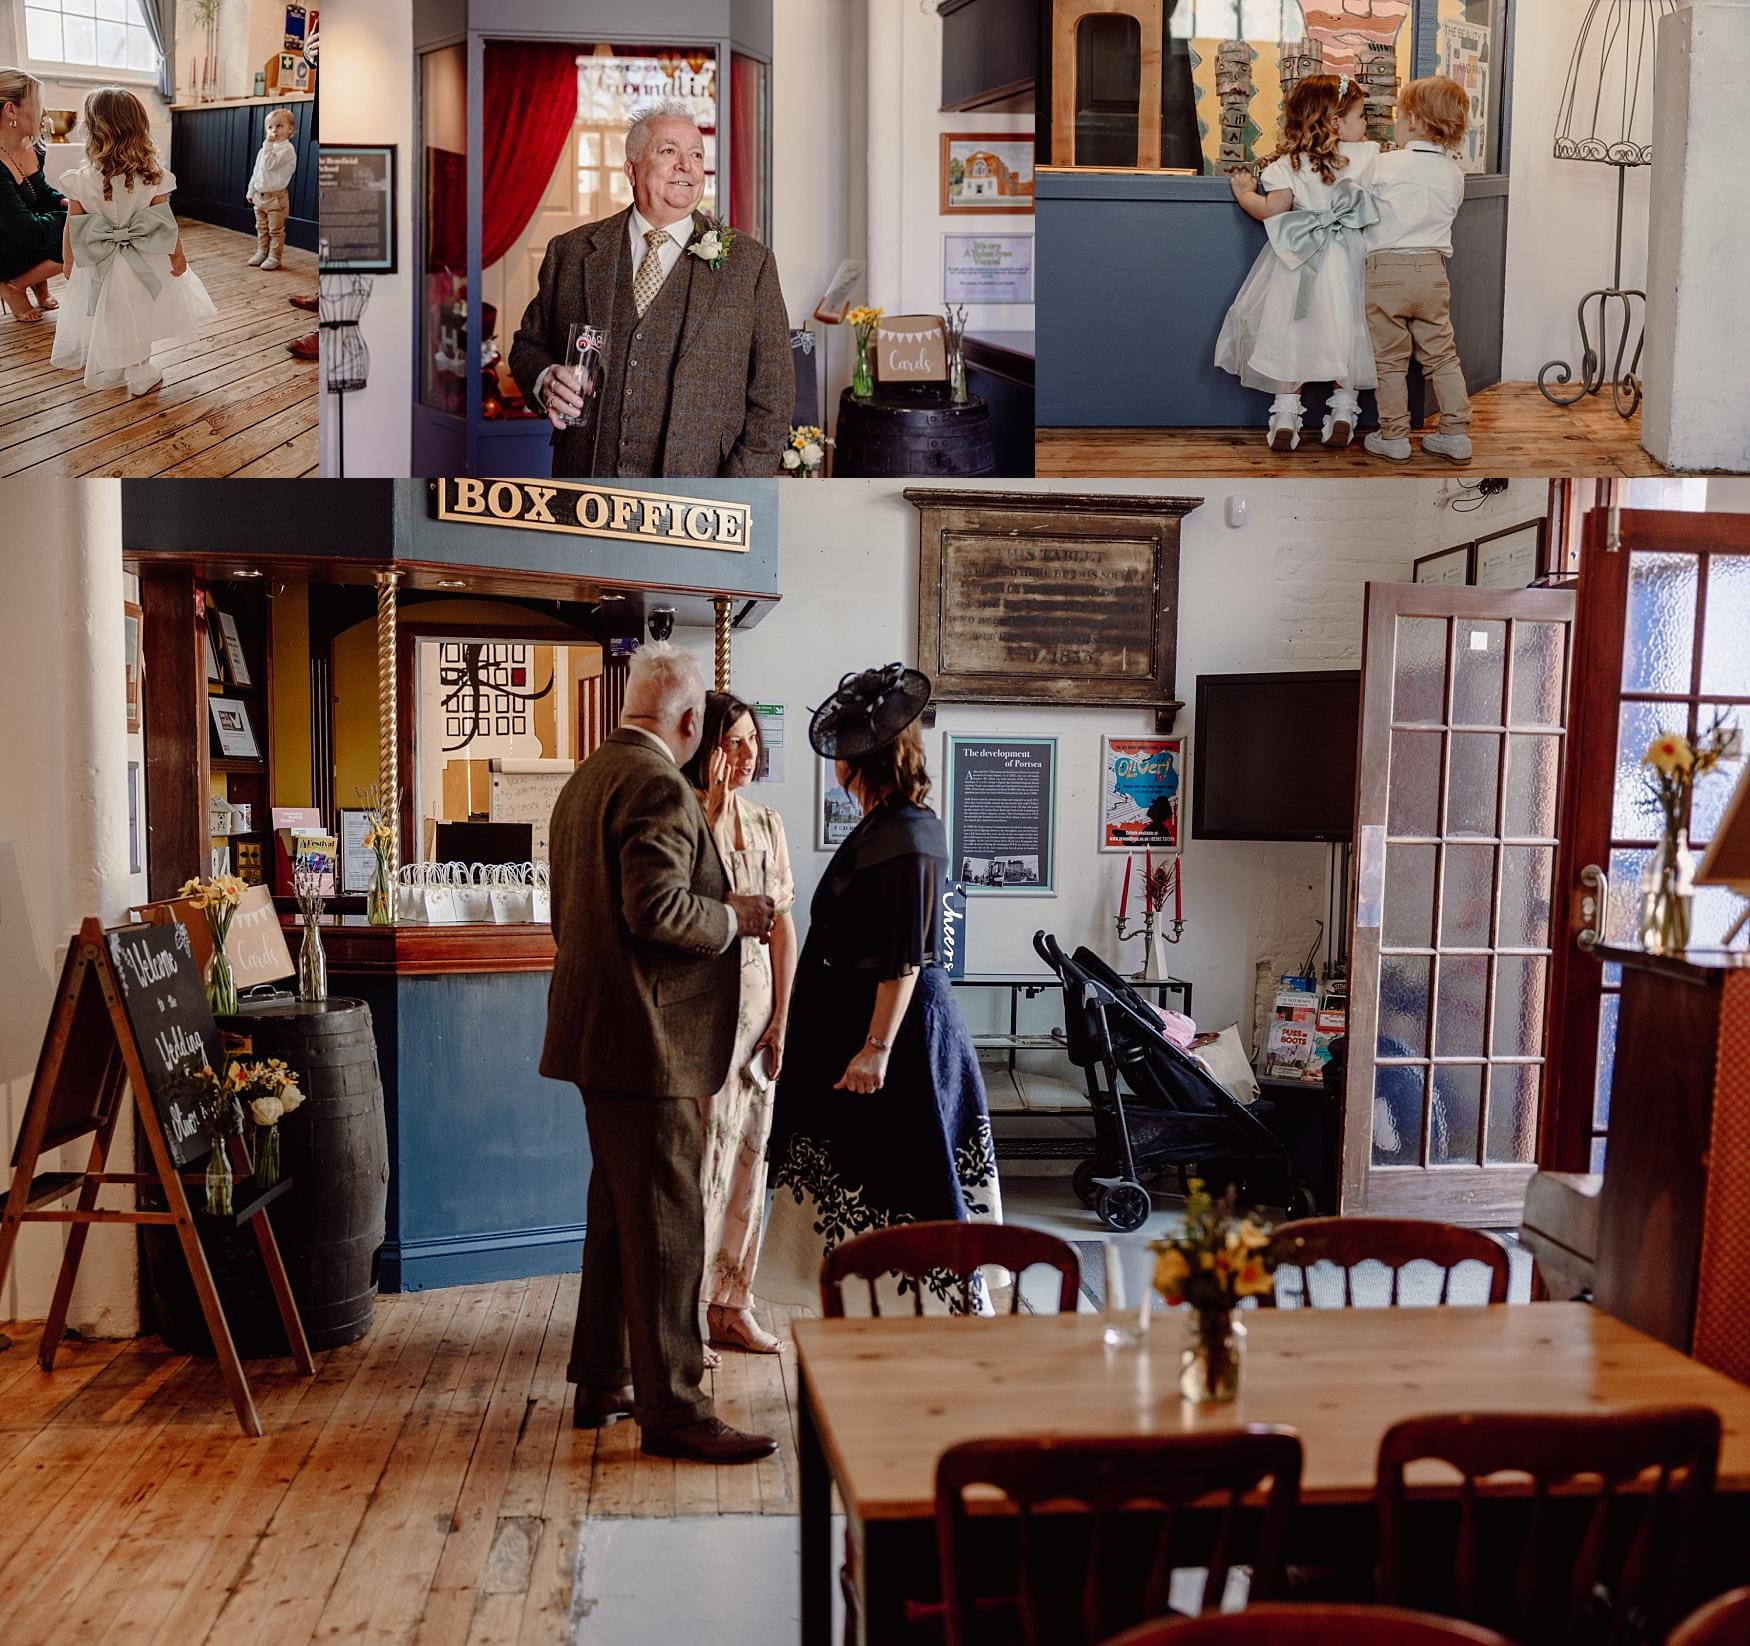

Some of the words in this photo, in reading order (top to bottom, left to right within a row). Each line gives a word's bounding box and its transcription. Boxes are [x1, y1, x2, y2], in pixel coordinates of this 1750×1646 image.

[889, 348, 931, 373] Cards
[453, 477, 555, 523] BOX
[575, 493, 742, 543] OFFICE
[962, 748, 979, 757] The
[979, 748, 1031, 760] development
[1004, 759, 1014, 768] of
[1014, 759, 1042, 768] Portsea
[307, 839, 335, 848] Festival
[942, 884, 963, 973] Cheers
[126, 939, 178, 988] Welcome
[237, 932, 280, 970] Cards
[1280, 1036, 1307, 1046] BOOTS
[1282, 1028, 1302, 1037] PUSS
[155, 1025, 209, 1072] Wedding
